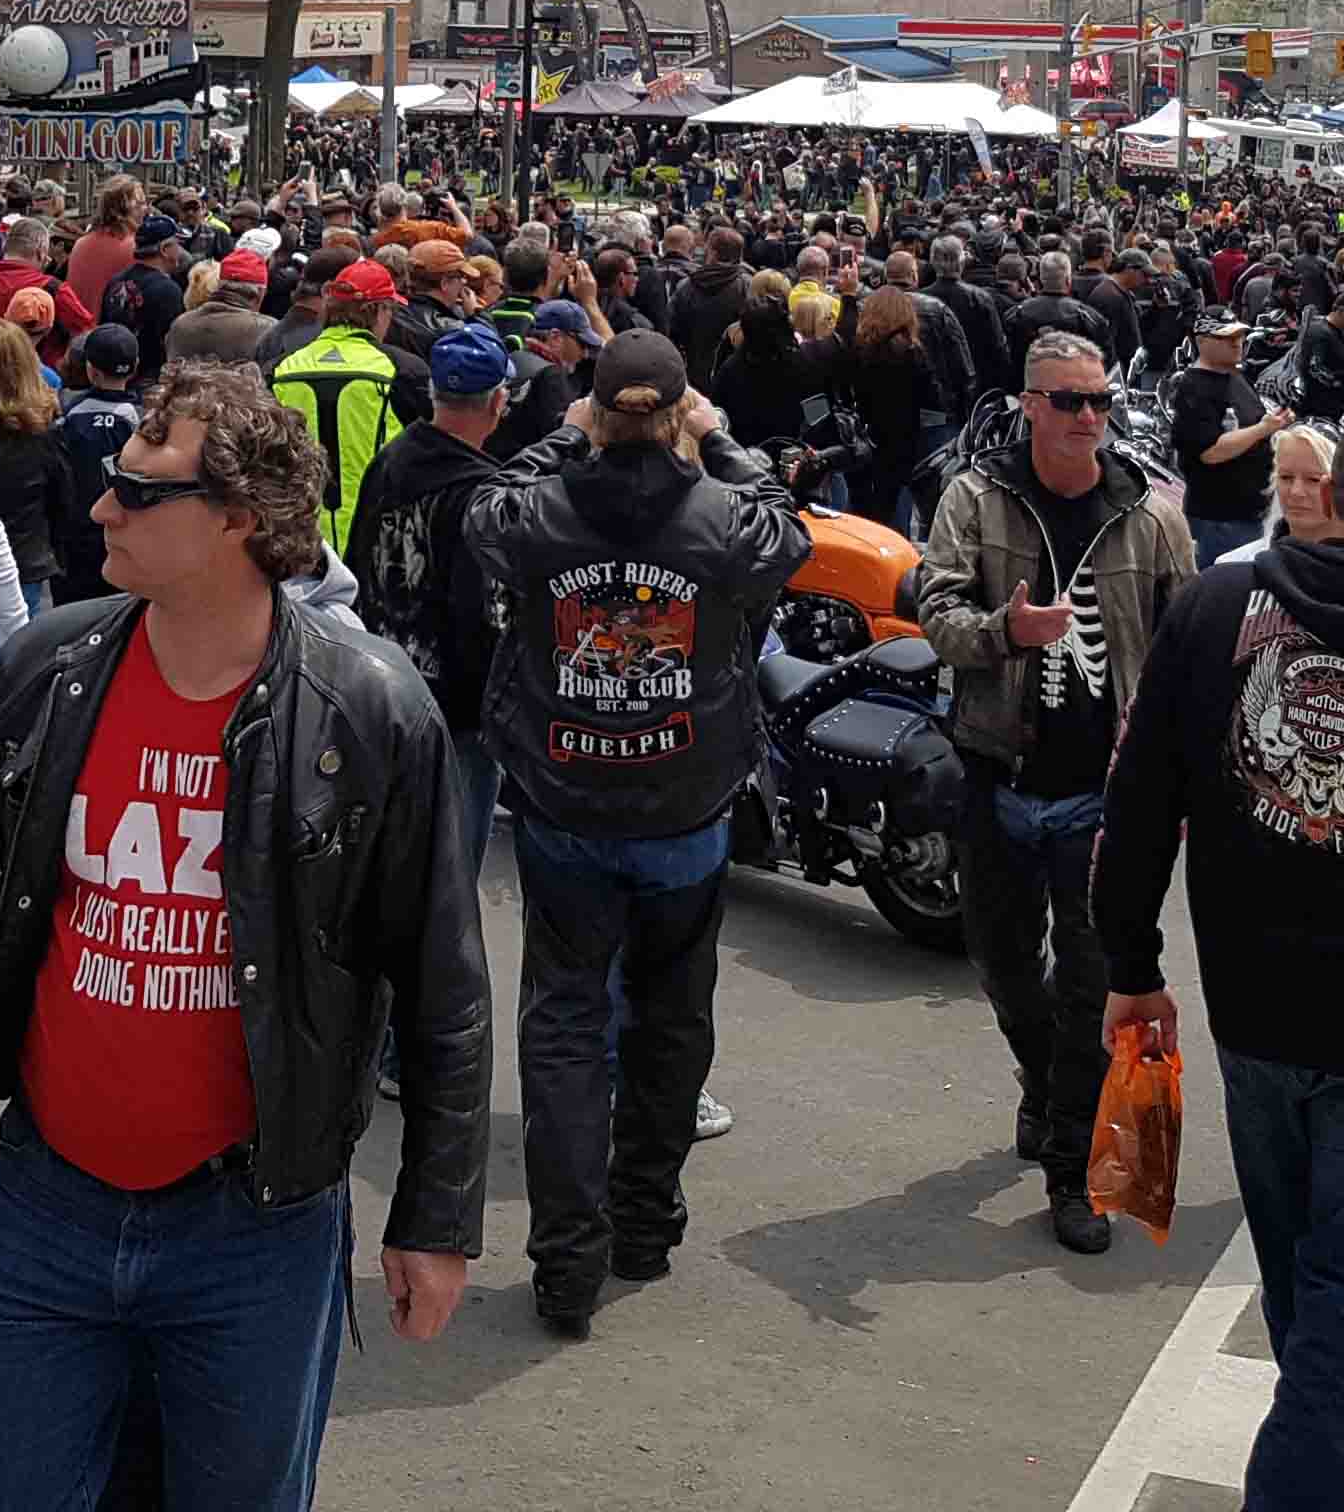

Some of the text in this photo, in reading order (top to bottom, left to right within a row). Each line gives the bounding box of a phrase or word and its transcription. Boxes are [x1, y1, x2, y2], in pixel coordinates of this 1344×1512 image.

[93, 413, 115, 427] 20
[548, 559, 699, 603] GHOST RIDERS
[556, 664, 693, 700] RIDING CLUB
[596, 700, 623, 713] EST.
[1306, 694, 1344, 714] MOTOR
[561, 729, 676, 757] GUELPH
[1303, 728, 1342, 750] CYCLES
[138, 746, 221, 799] I'M NOT
[1252, 797, 1301, 841] RIDE
[65, 793, 224, 899] LAZ
[69, 885, 80, 928] I
[77, 891, 119, 945] JUST
[121, 904, 210, 955] REALLY
[72, 947, 135, 1007] DOING
